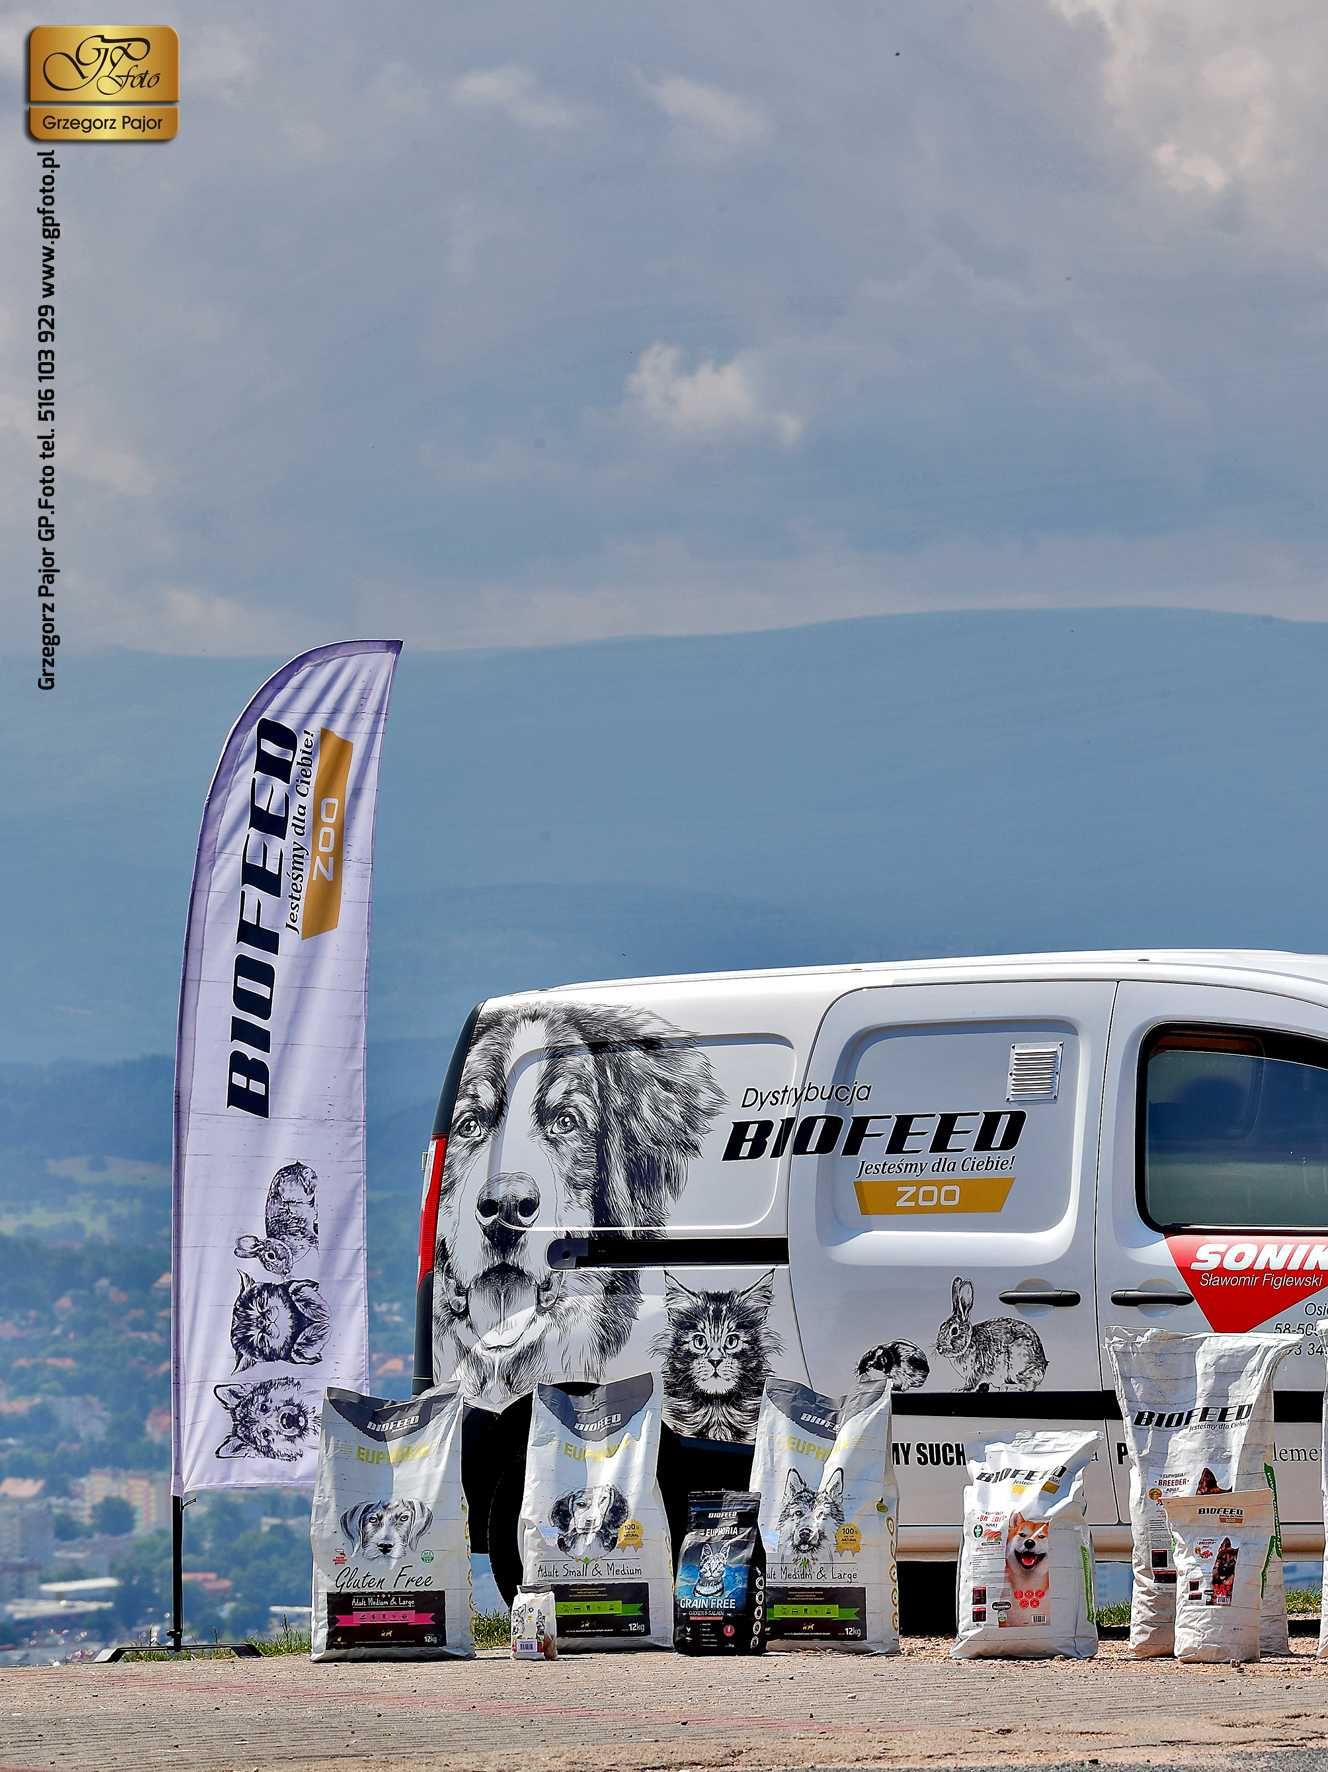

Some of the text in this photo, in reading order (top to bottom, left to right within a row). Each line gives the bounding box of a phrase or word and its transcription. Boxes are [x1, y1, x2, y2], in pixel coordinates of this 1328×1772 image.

[285, 728, 314, 934] Jesteśmy dla Ciebie!
[312, 796, 338, 882] ZOO
[226, 718, 298, 1119] BIOFEED
[741, 1082, 872, 1111] Dystrybucja
[722, 1110, 1027, 1161] BIOFEED
[856, 1156, 1015, 1178] Jesteśmy dla Ciebie!
[896, 1185, 960, 1207] ZOO
[1200, 1273, 1323, 1289] Sławomir Figlewski
[1274, 1323, 1318, 1336] 58-50
[1307, 1343, 1327, 1355] 34
[1134, 1404, 1253, 1428] BIOFEED
[892, 1443, 966, 1466] MY SUCH
[1273, 1441, 1320, 1462] leme
[706, 1527, 738, 1536] EUPHORIA
[335, 1565, 433, 1592] Gluten Free
[537, 1563, 642, 1577] Adult Small & Medium
[767, 1565, 857, 1583] ult Medium & Large
[399, 1597, 415, 1608] Large
[680, 1599, 736, 1609] GRAIN FREE
[629, 1623, 644, 1633] 12kg
[845, 1628, 861, 1637] 12kg
